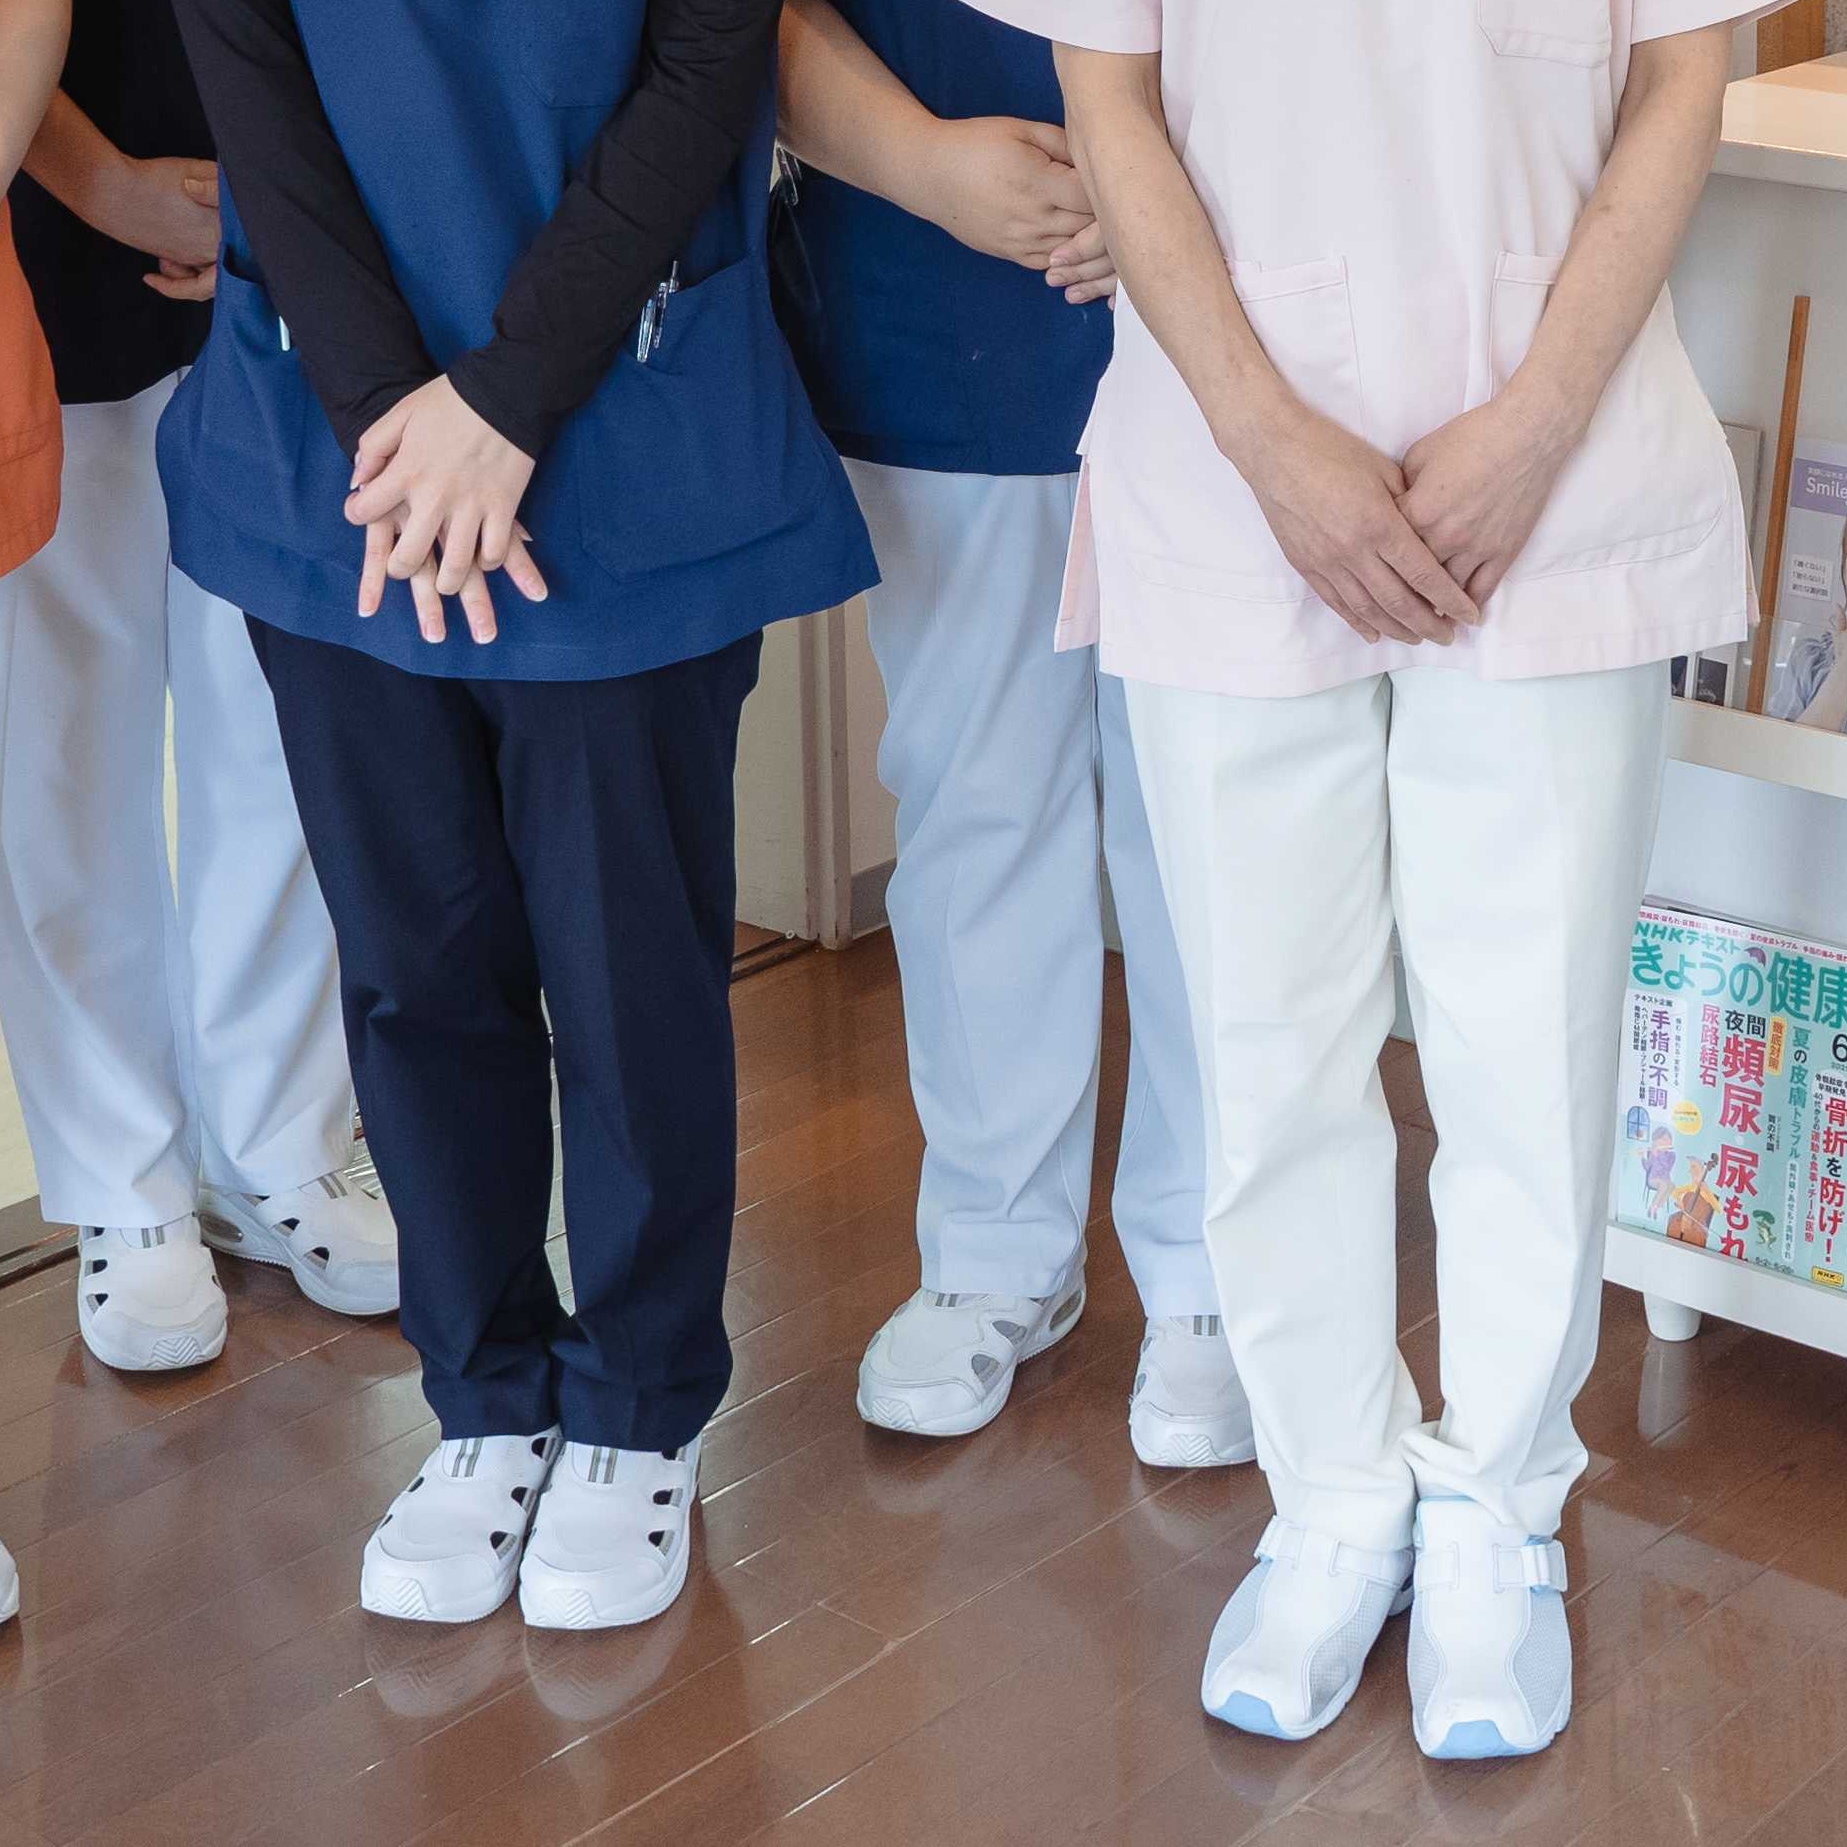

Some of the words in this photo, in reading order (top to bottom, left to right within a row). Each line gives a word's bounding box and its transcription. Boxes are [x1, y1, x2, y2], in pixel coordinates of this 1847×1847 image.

[1634, 920, 1744, 955] NHKテキスト
[1648, 1009, 1671, 1110] 手指の不調
[1699, 1003, 1721, 1088] 尿路結石
[1724, 1009, 1767, 1039] 夜間
[1787, 1025, 1812, 1160] 夏の皮膚トラブル
